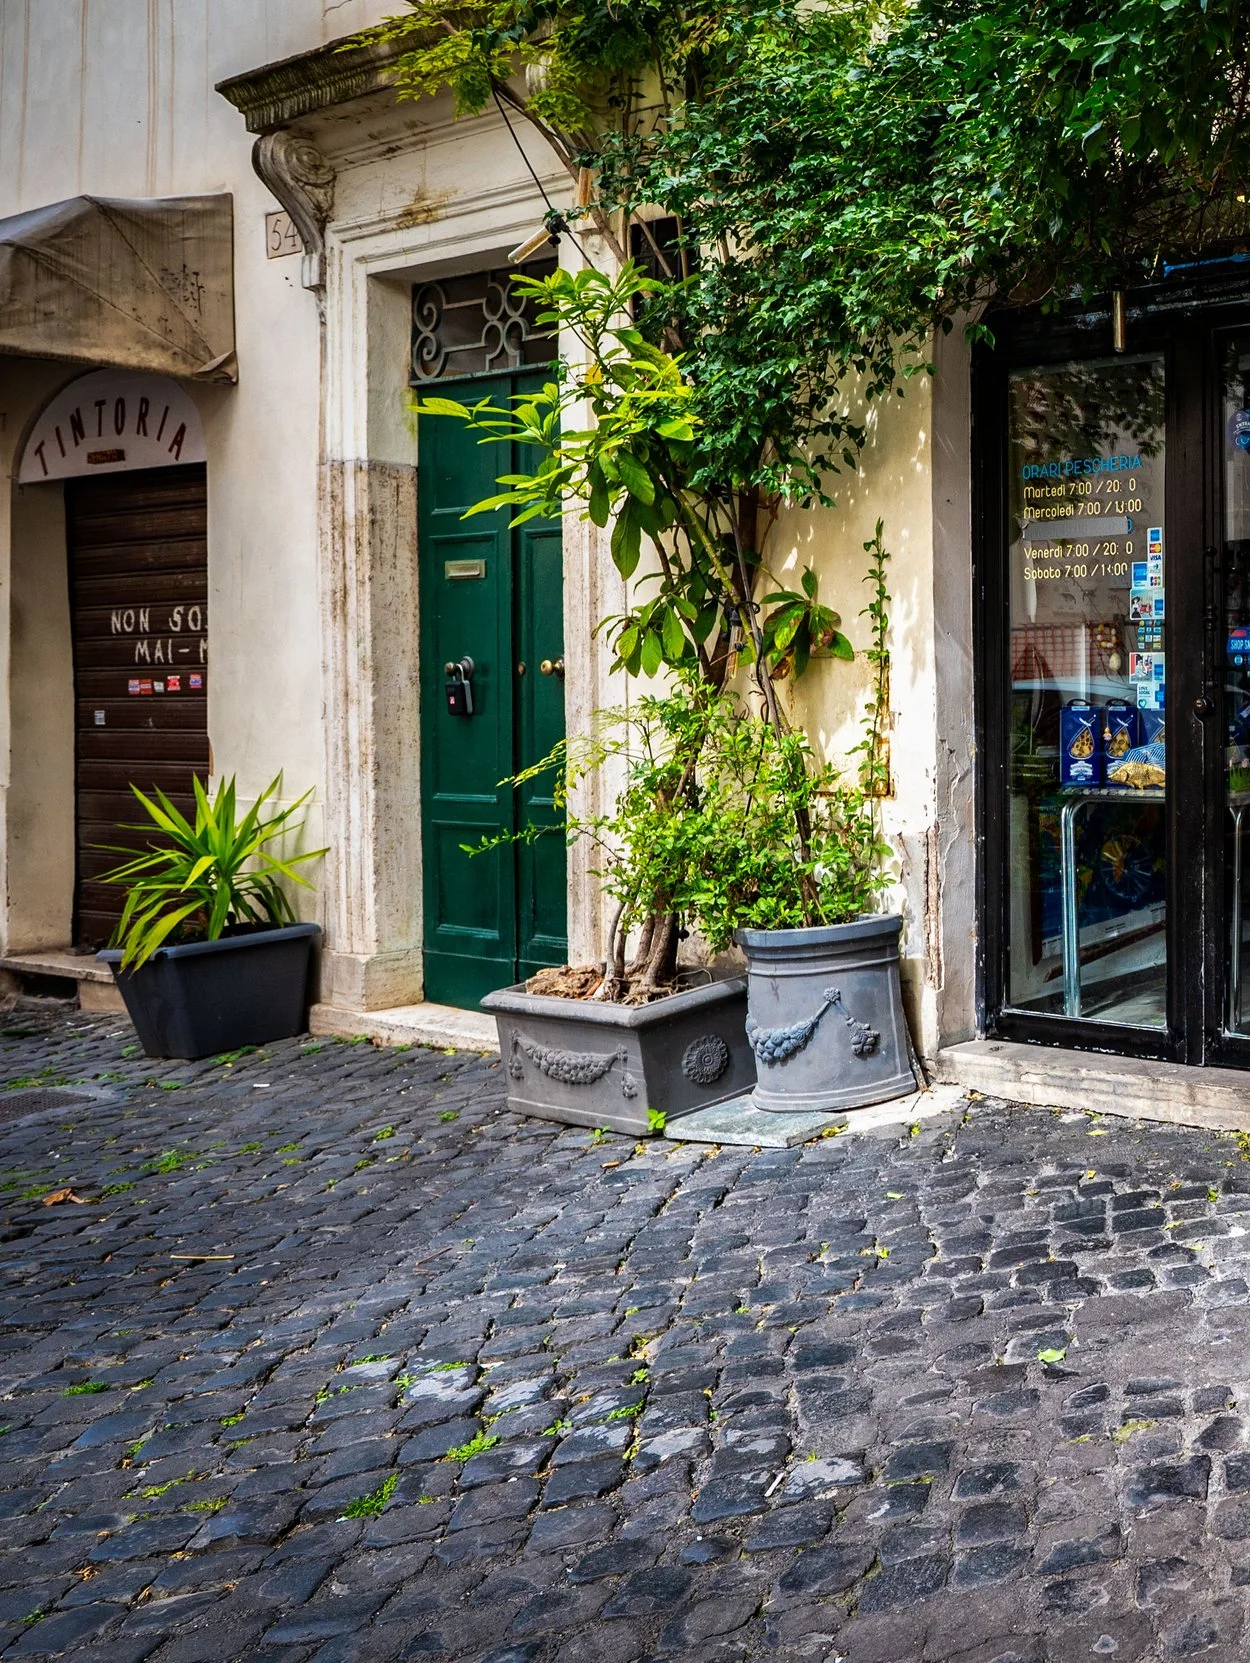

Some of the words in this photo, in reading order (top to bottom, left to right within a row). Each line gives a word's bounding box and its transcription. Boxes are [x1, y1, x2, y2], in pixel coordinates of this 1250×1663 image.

[271, 218, 298, 251] 54
[34, 396, 187, 476] TINTORIA
[1022, 463, 1061, 480] ORARI
[1065, 455, 1142, 475] PESCHERIA
[1069, 481, 1092, 496] 7:00
[1077, 500, 1101, 516] 7:00
[1066, 543, 1089, 557] 7:00
[1023, 565, 1061, 580] Sabato
[1065, 564, 1087, 578] 7:00
[111, 607, 150, 634] NON
[168, 605, 208, 632] SO
[1230, 639, 1244, 650] SHOP
